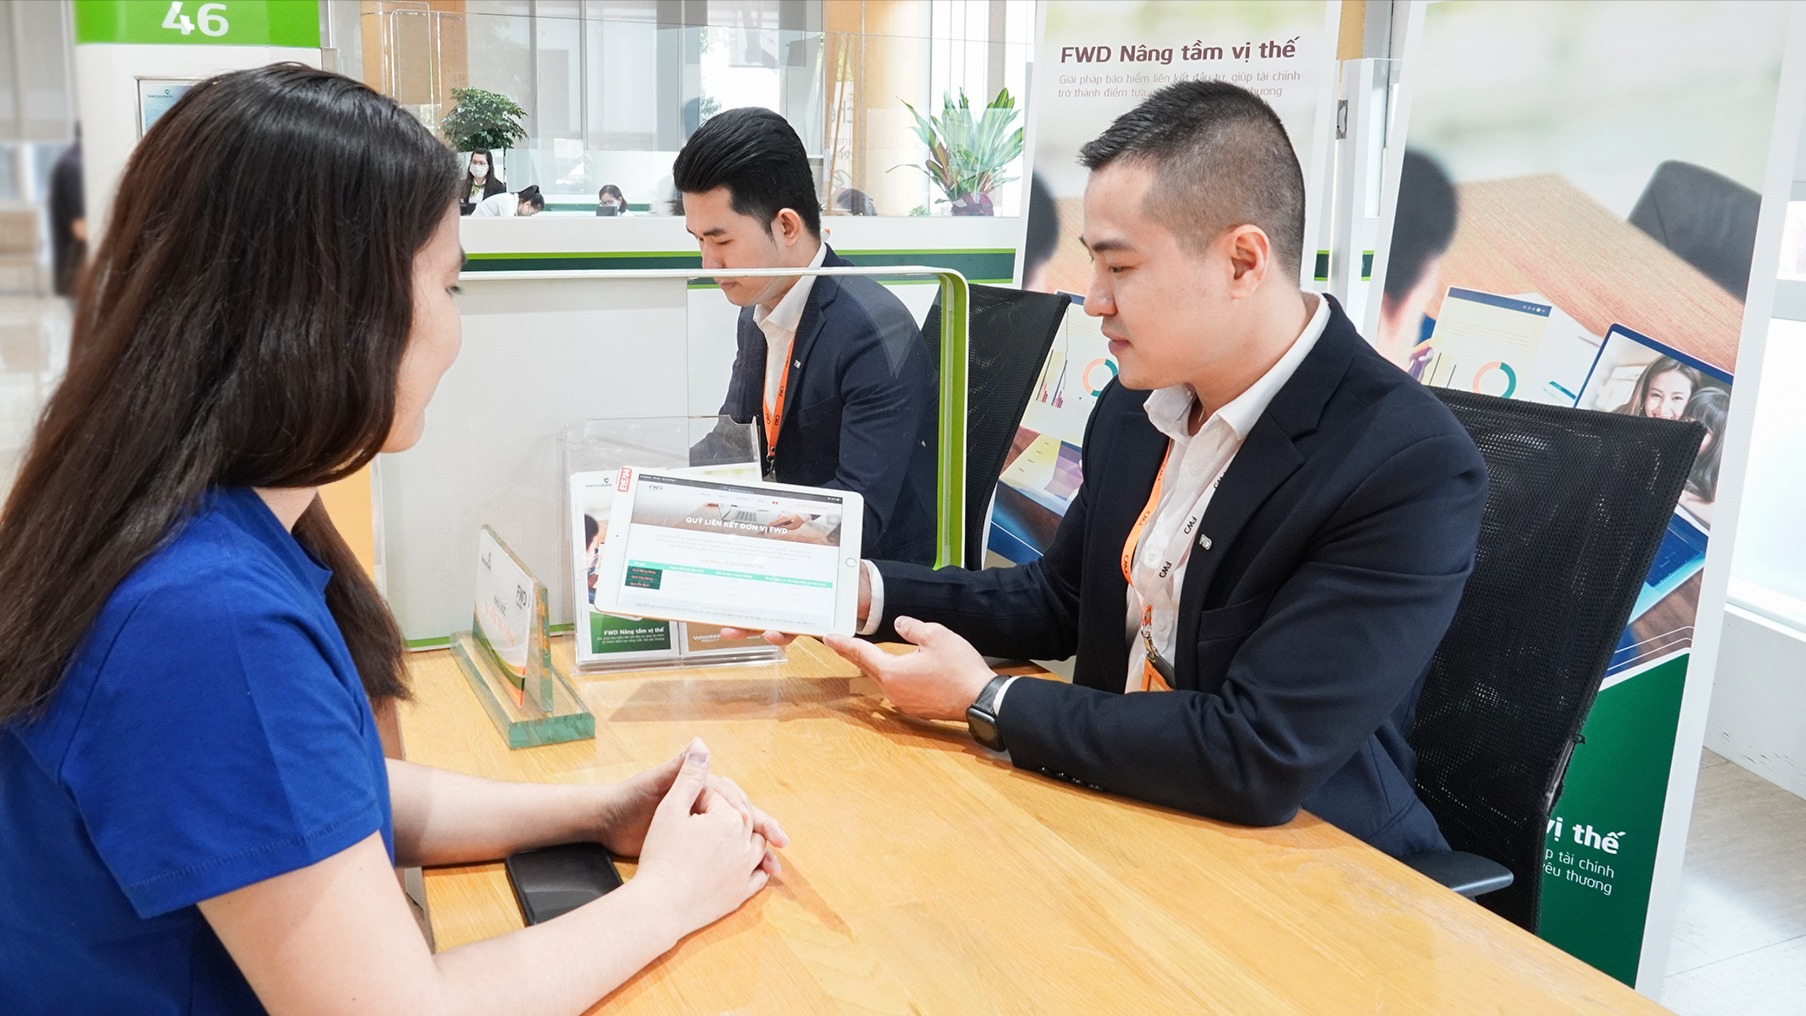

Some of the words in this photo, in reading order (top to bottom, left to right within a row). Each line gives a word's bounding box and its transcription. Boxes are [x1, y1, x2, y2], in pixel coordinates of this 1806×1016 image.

[162, 1, 229, 37] 46
[1061, 45, 1112, 63] FWD
[1120, 44, 1173, 65] Nâng
[1181, 39, 1223, 61] tầm
[1232, 42, 1251, 63] vị
[1259, 35, 1300, 59] thế
[1153, 73, 1170, 83] liên
[1231, 71, 1253, 84] giúp
[1272, 70, 1300, 81] chính
[1104, 86, 1128, 98] điểm
[685, 516, 704, 525] QUỸ
[704, 518, 722, 527] LIÊN
[723, 519, 739, 529] KẾT
[769, 526, 788, 534] FWD
[1183, 516, 1198, 534] FWD
[1159, 561, 1172, 578] FWD
[1572, 823, 1626, 855] thế
[1558, 851, 1575, 865] tài
[1579, 859, 1615, 878] chính
[1543, 861, 1561, 877] êu
[1566, 869, 1612, 896] thương
